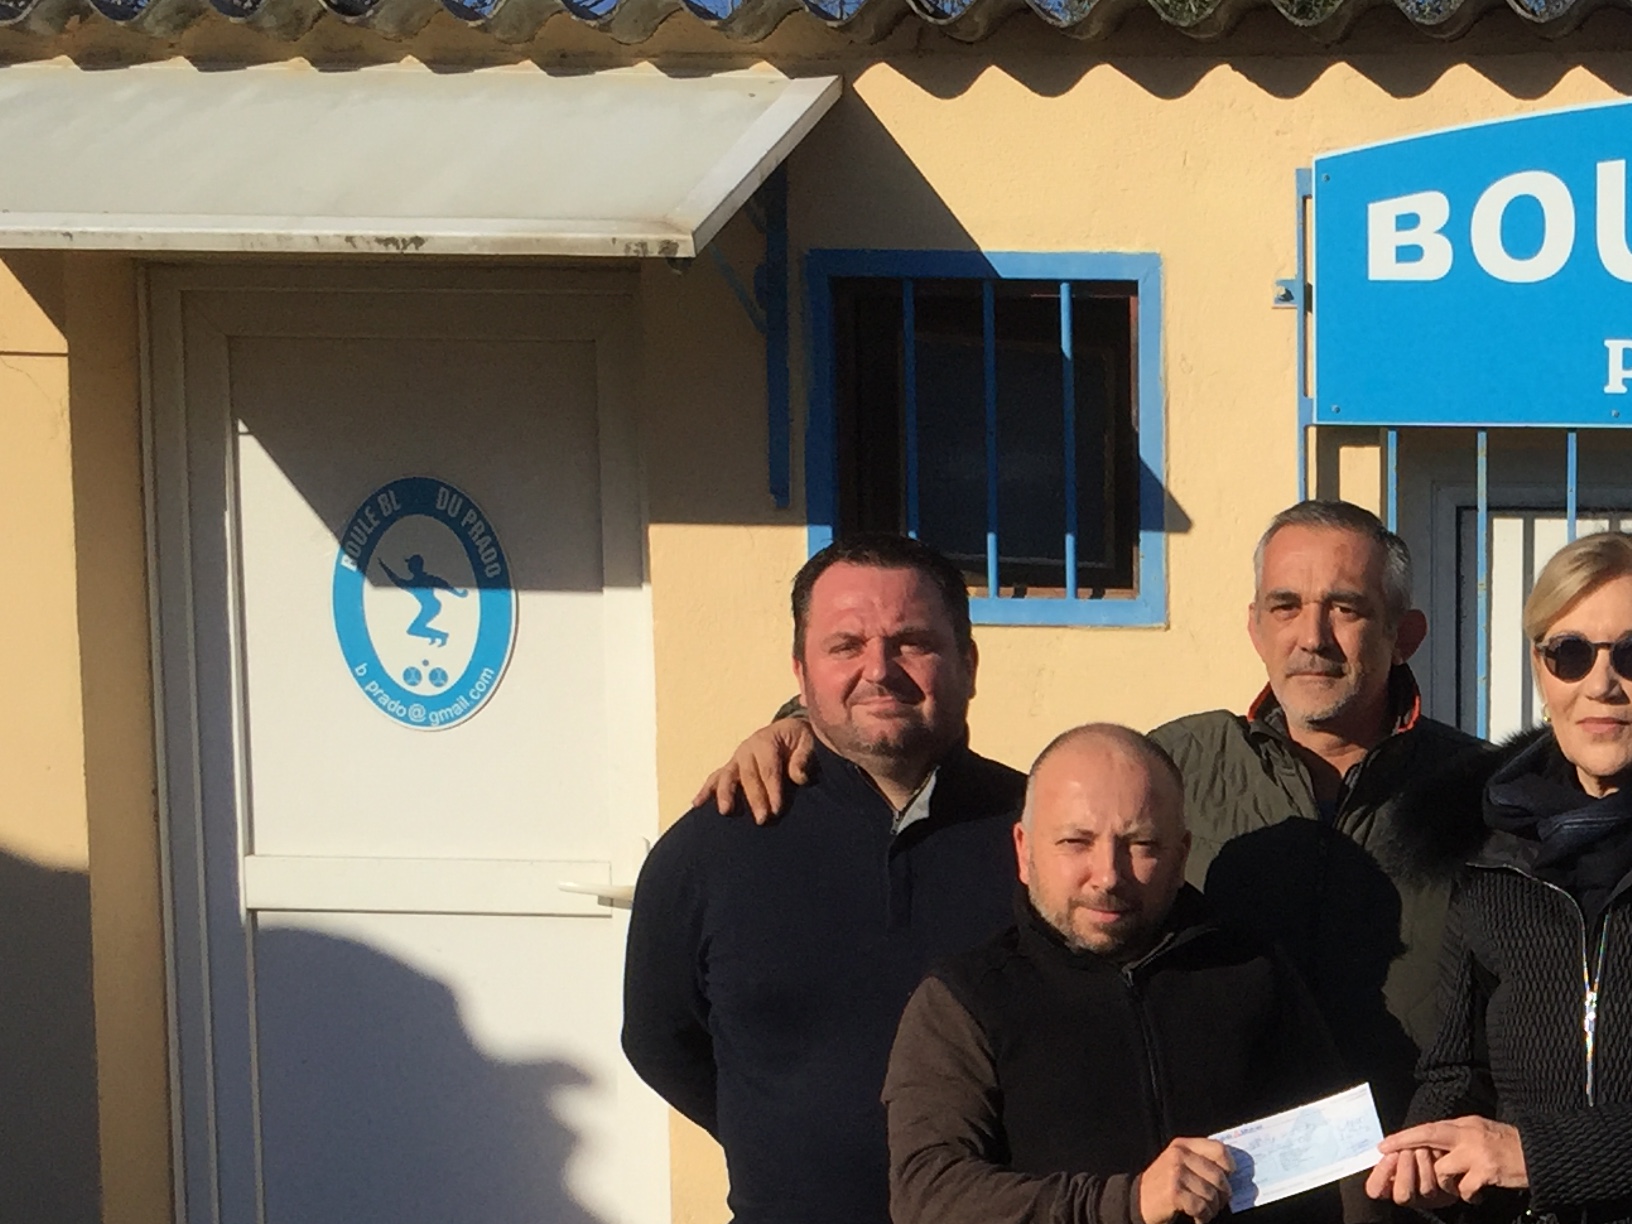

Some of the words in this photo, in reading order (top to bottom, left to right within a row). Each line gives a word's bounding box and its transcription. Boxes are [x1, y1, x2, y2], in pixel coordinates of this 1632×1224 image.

[341, 506, 380, 572] BOULE
[436, 487, 463, 518] DU
[461, 509, 502, 578] PRADO
